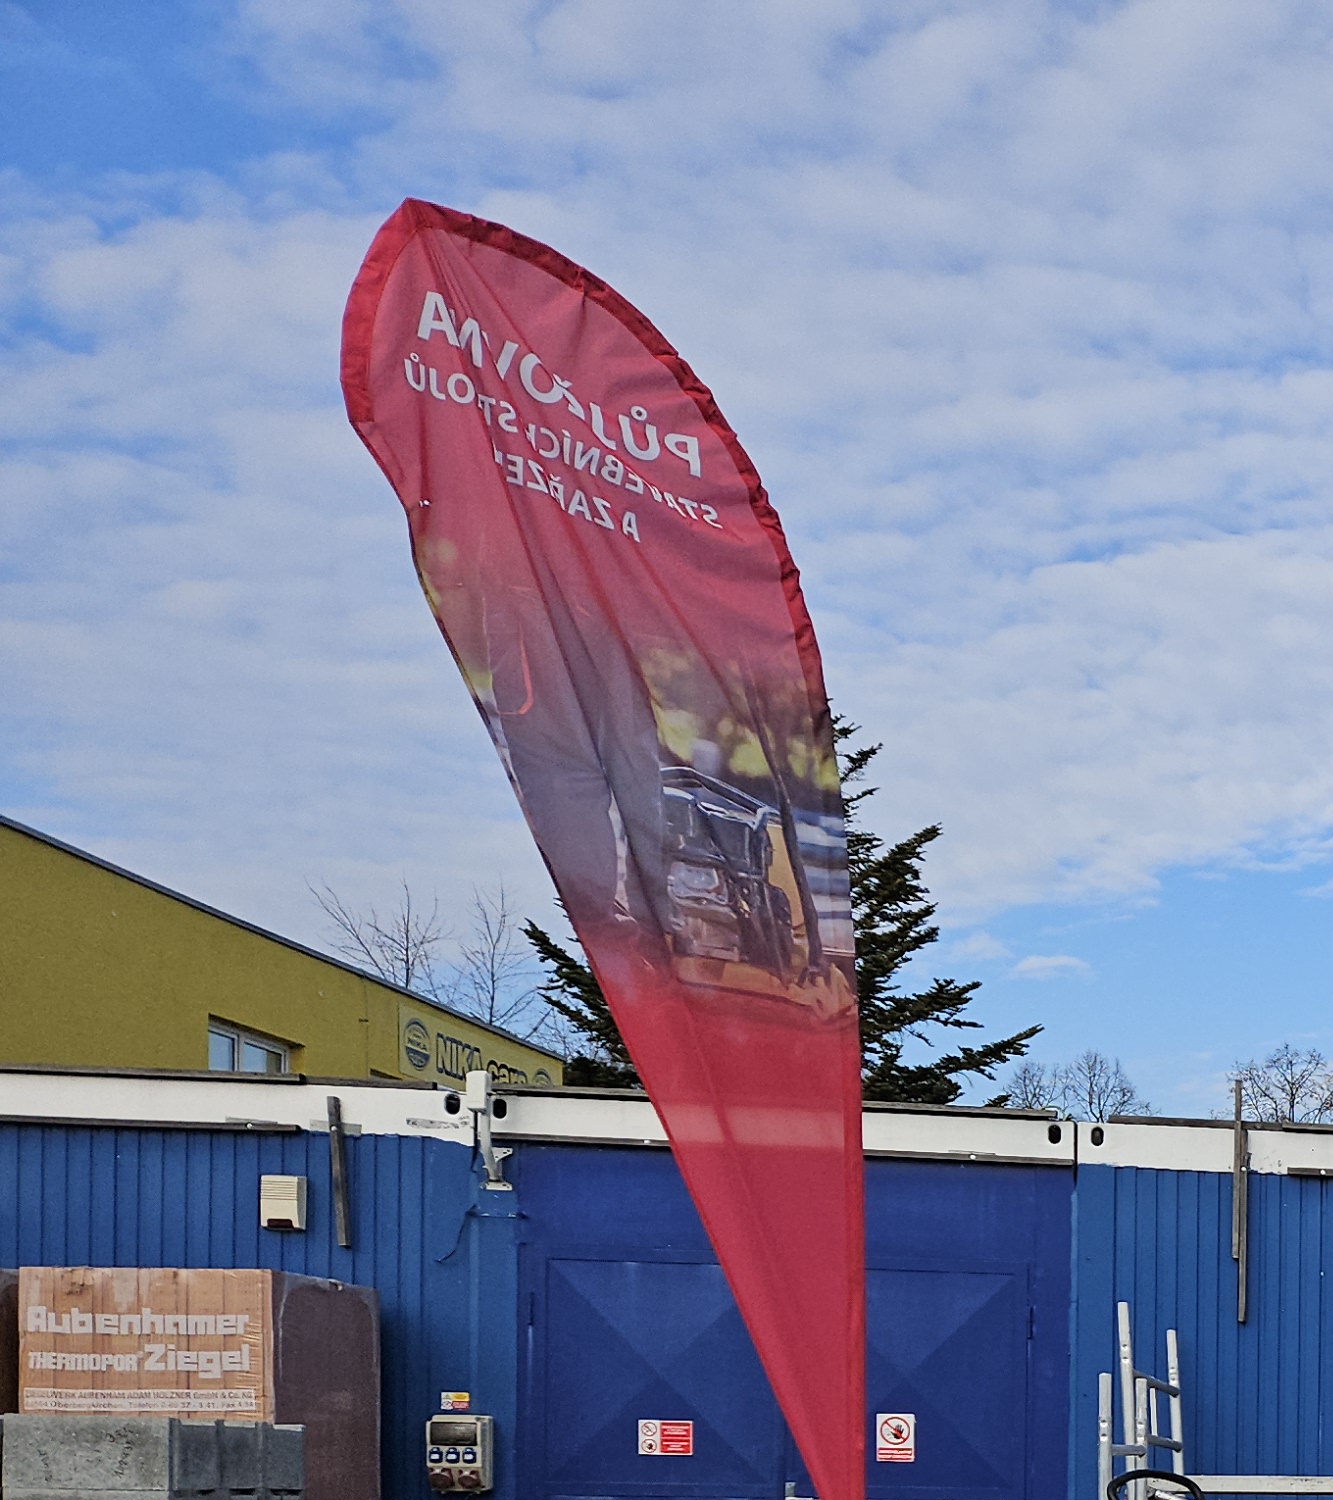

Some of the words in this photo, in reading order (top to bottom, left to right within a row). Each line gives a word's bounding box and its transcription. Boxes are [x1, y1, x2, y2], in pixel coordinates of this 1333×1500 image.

[436, 1032, 483, 1082] NIKA
[27, 1305, 249, 1335] Aubenhamer
[144, 1343, 250, 1379] Ziegel
